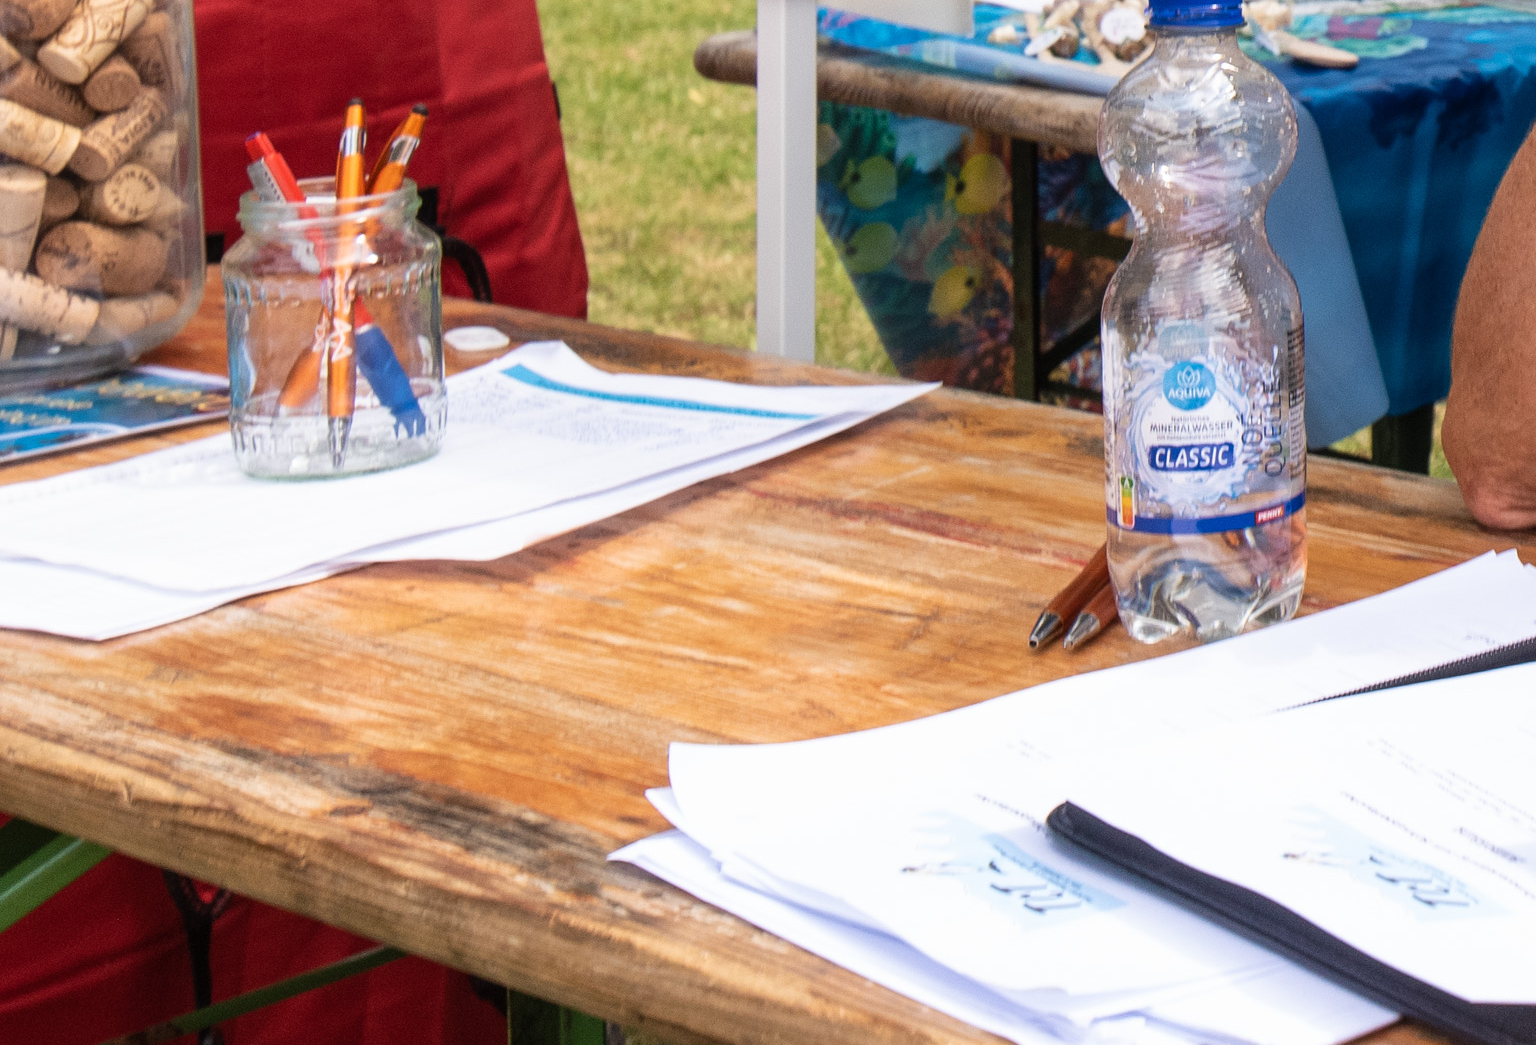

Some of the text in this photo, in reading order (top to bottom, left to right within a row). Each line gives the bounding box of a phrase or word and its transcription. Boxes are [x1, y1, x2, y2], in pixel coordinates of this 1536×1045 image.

[1168, 387, 1211, 401] AQUIVA
[1149, 421, 1233, 433] MINERALWASSER
[1155, 445, 1229, 468] CLASSIC
